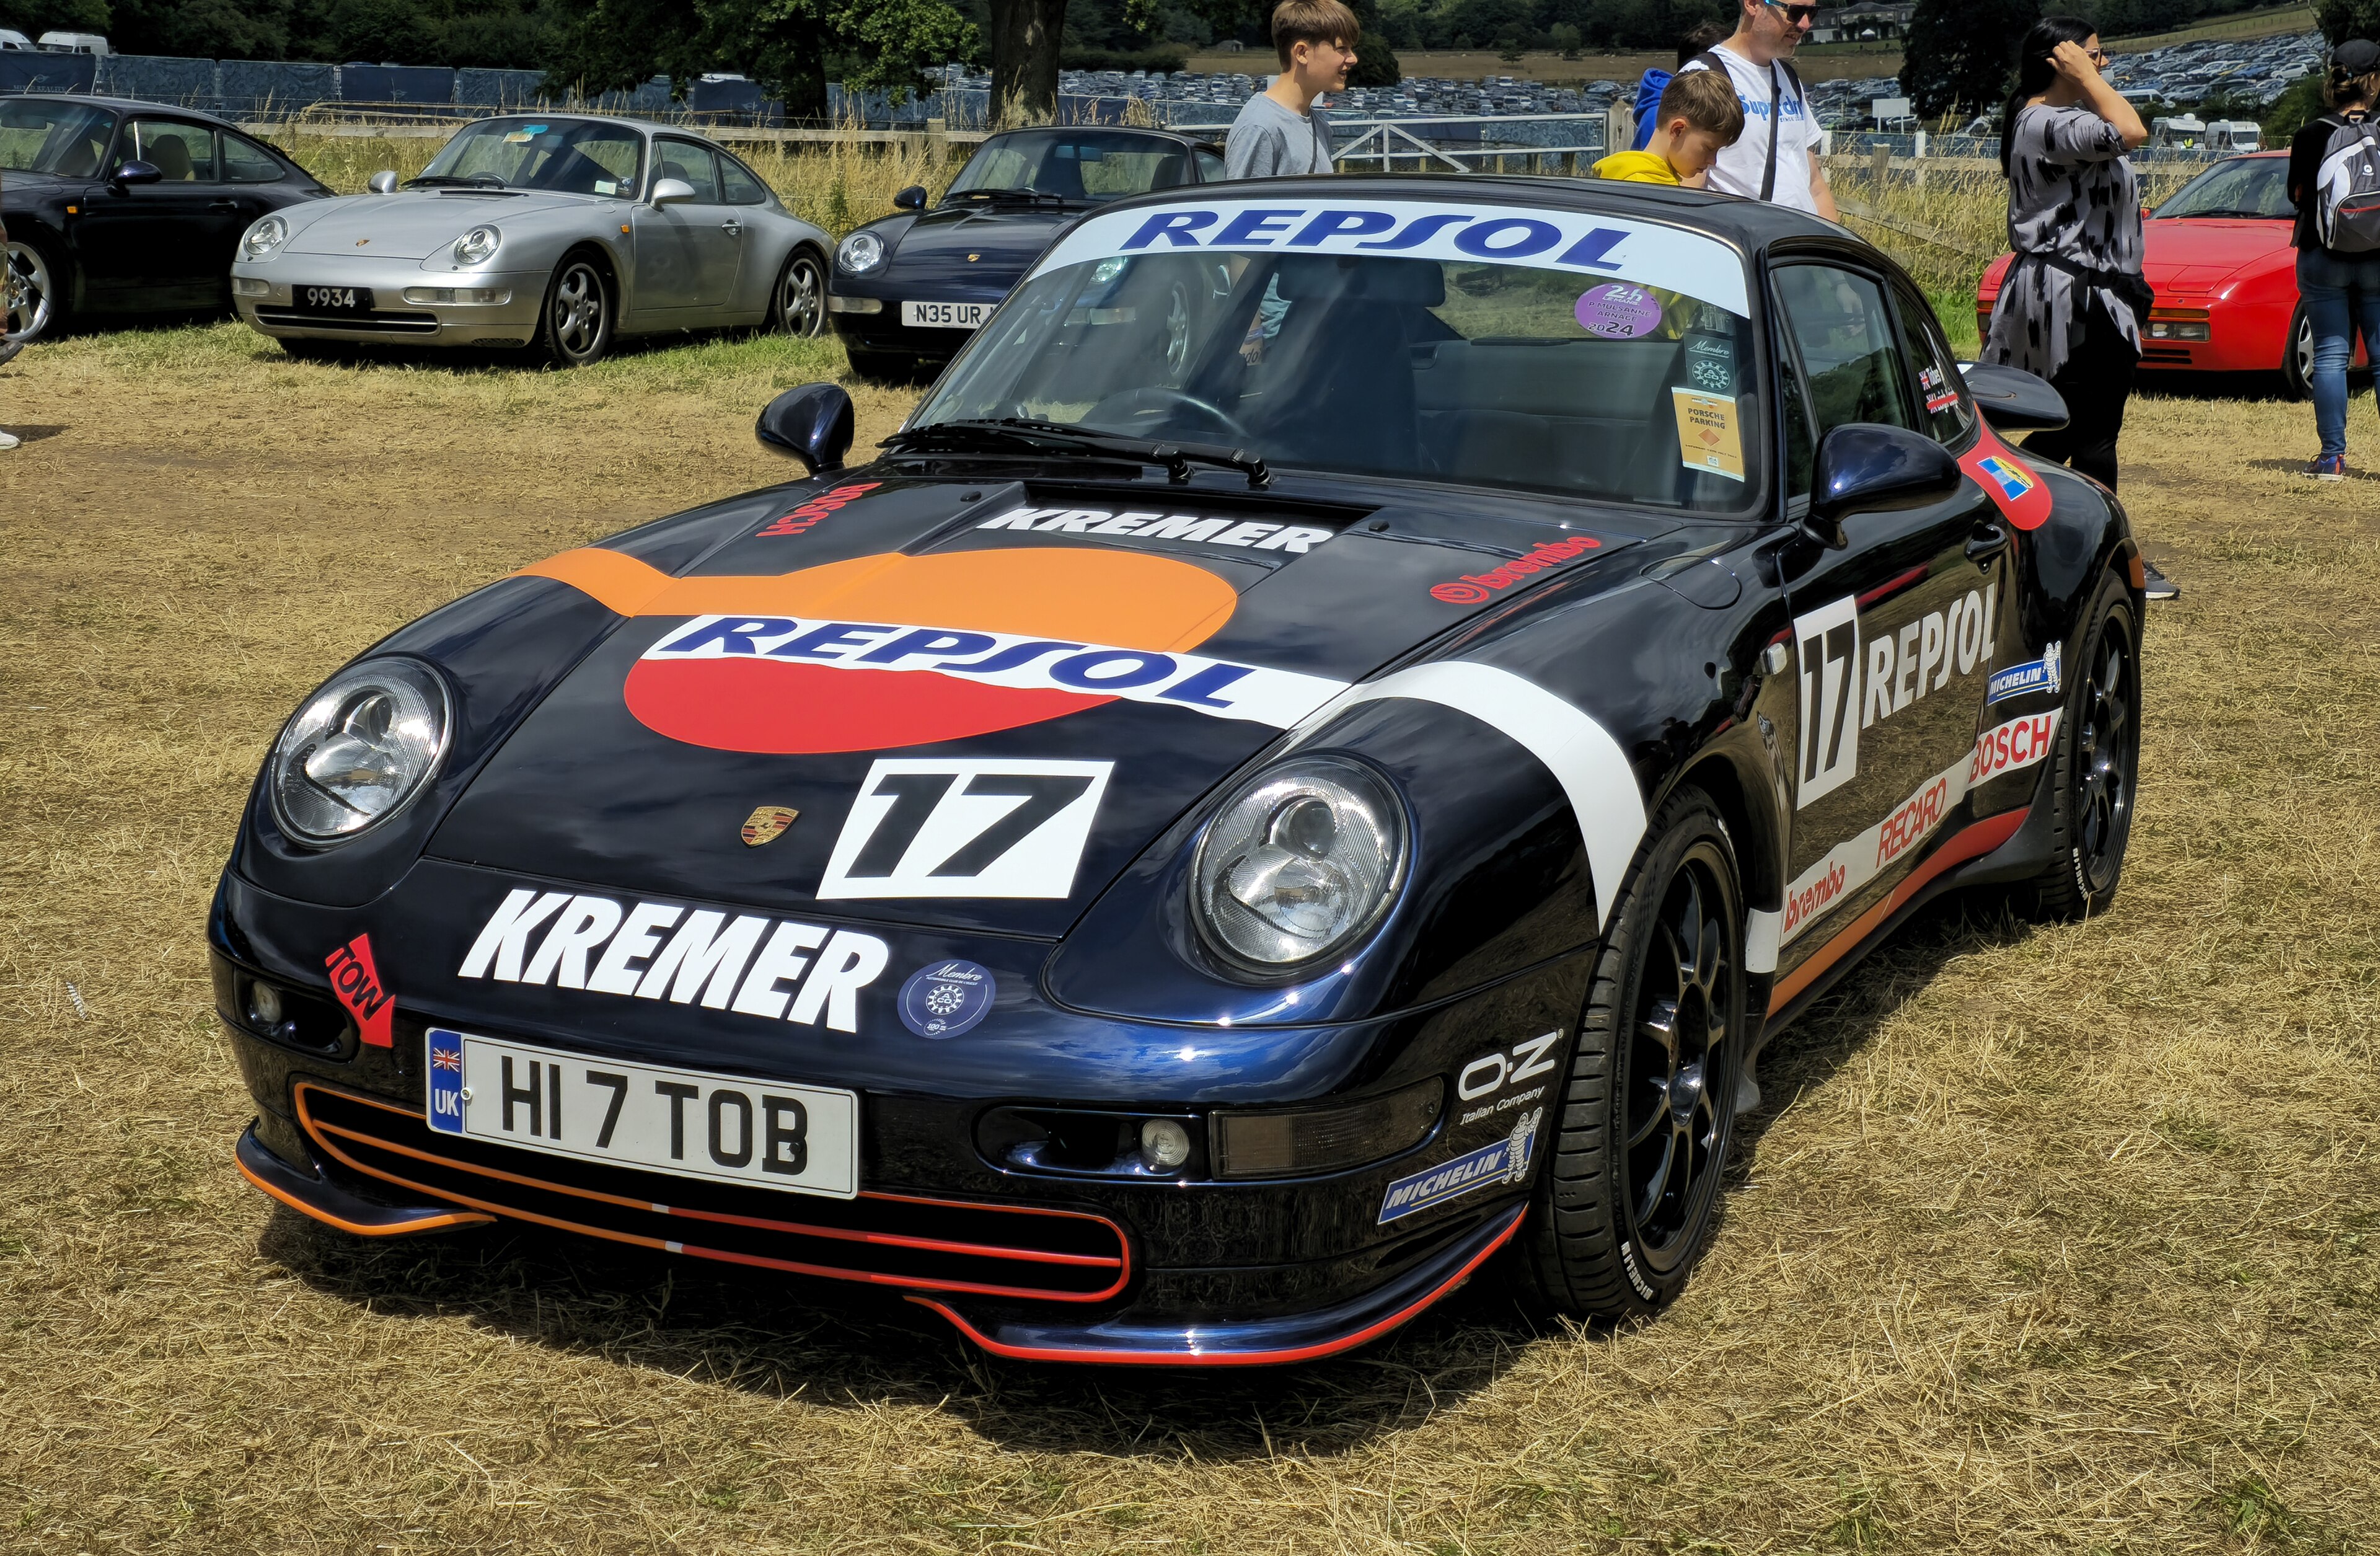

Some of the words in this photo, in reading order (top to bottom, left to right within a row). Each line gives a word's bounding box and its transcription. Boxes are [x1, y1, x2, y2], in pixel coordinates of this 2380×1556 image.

[1121, 210, 1631, 271] REPSOL
[307, 288, 356, 307] 9934
[916, 304, 951, 322] N35
[957, 306, 993, 324] UR
[1597, 303, 1651, 317] MULSANNE
[1597, 311, 1637, 322] ARNAGE
[1588, 321, 1634, 336] 2024
[1688, 340, 1730, 355] Membre
[1688, 407, 1726, 421] PORSCHE
[1689, 416, 1726, 430] PARKING
[757, 482, 883, 537] BOSCH
[975, 508, 1334, 554] KREMER
[1459, 536, 1601, 590] brembo
[659, 617, 1256, 708] REPSOL
[1803, 619, 1855, 784] 17
[1862, 582, 1995, 730] REPSOL
[1989, 667, 2042, 696] MICHELIN
[1968, 715, 2052, 784] BOSCH
[844, 774, 1095, 878] 17
[1784, 860, 1846, 934] brembo
[1875, 777, 1946, 869] RECARO
[325, 944, 389, 1022] TOW
[457, 888, 890, 1033] KREMER
[925, 963, 983, 981] Membre
[435, 1089, 459, 1117] UK
[654, 1079, 808, 1176] TOB
[1460, 1105, 1494, 1125] Italian
[1496, 1086, 1545, 1112] Company
[1385, 1151, 1502, 1209] MICHELIN
[1621, 1240, 1654, 1301] MICHELIN
